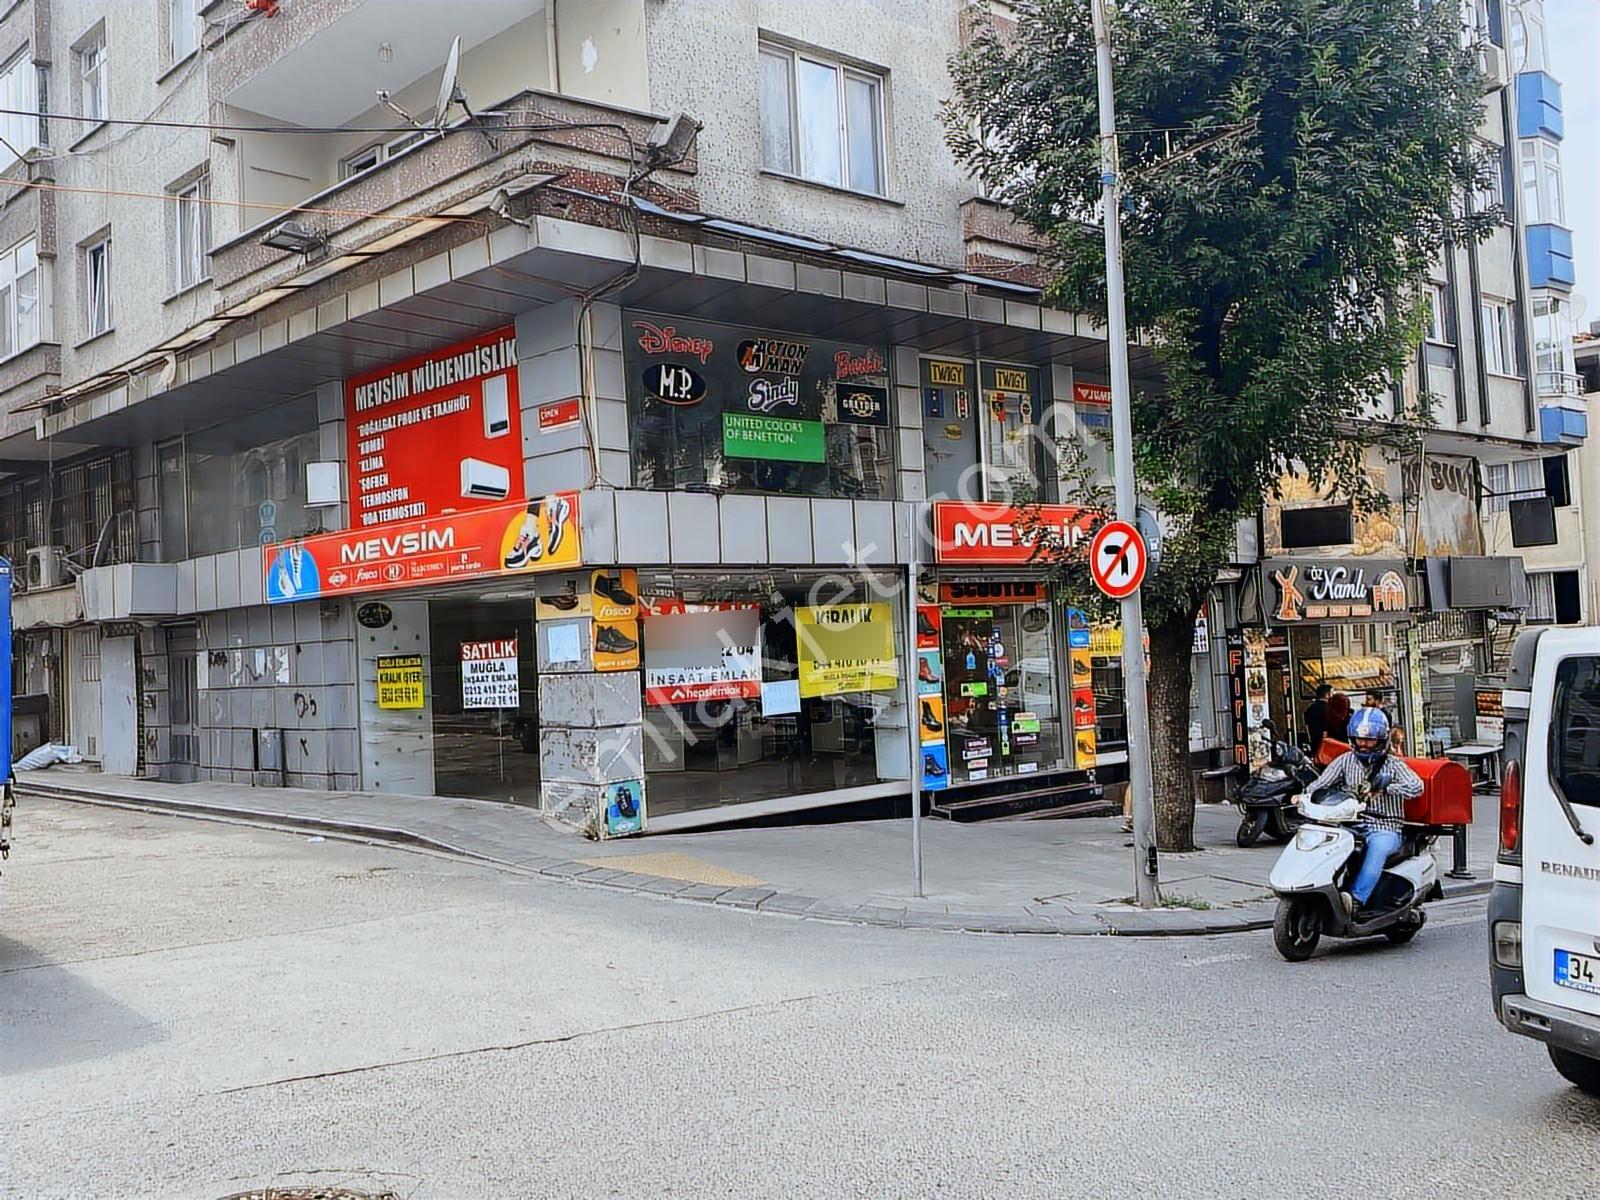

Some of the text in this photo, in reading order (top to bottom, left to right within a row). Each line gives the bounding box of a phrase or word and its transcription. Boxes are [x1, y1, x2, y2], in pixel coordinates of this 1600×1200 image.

[632, 320, 713, 365] Disney
[757, 338, 810, 359] ACTION
[355, 338, 517, 411] MEVSİM MÜHENDİSLİK
[765, 357, 804, 375] MAN
[932, 364, 962, 382] TWIGY
[997, 371, 1025, 389] TWIGY
[747, 376, 798, 412] Sindy
[397, 410, 421, 427] PROJE
[421, 406, 431, 421] VE
[433, 393, 471, 418] TAAHHÜT
[725, 416, 803, 432] UNITED COLORS
[725, 429, 740, 439] OF
[360, 435, 384, 455] KOMBİ
[361, 456, 384, 472] KLİMA
[362, 487, 408, 508] TERMOSİFON
[363, 502, 425, 526] ODA TERMOSTATI
[341, 525, 454, 563] MEVSİM
[462, 640, 515, 660] SATILIK
[651, 669, 758, 686] İNŞAAT EMLAK
[509, 695, 517, 705] 11
[1570, 957, 1594, 983] 34
